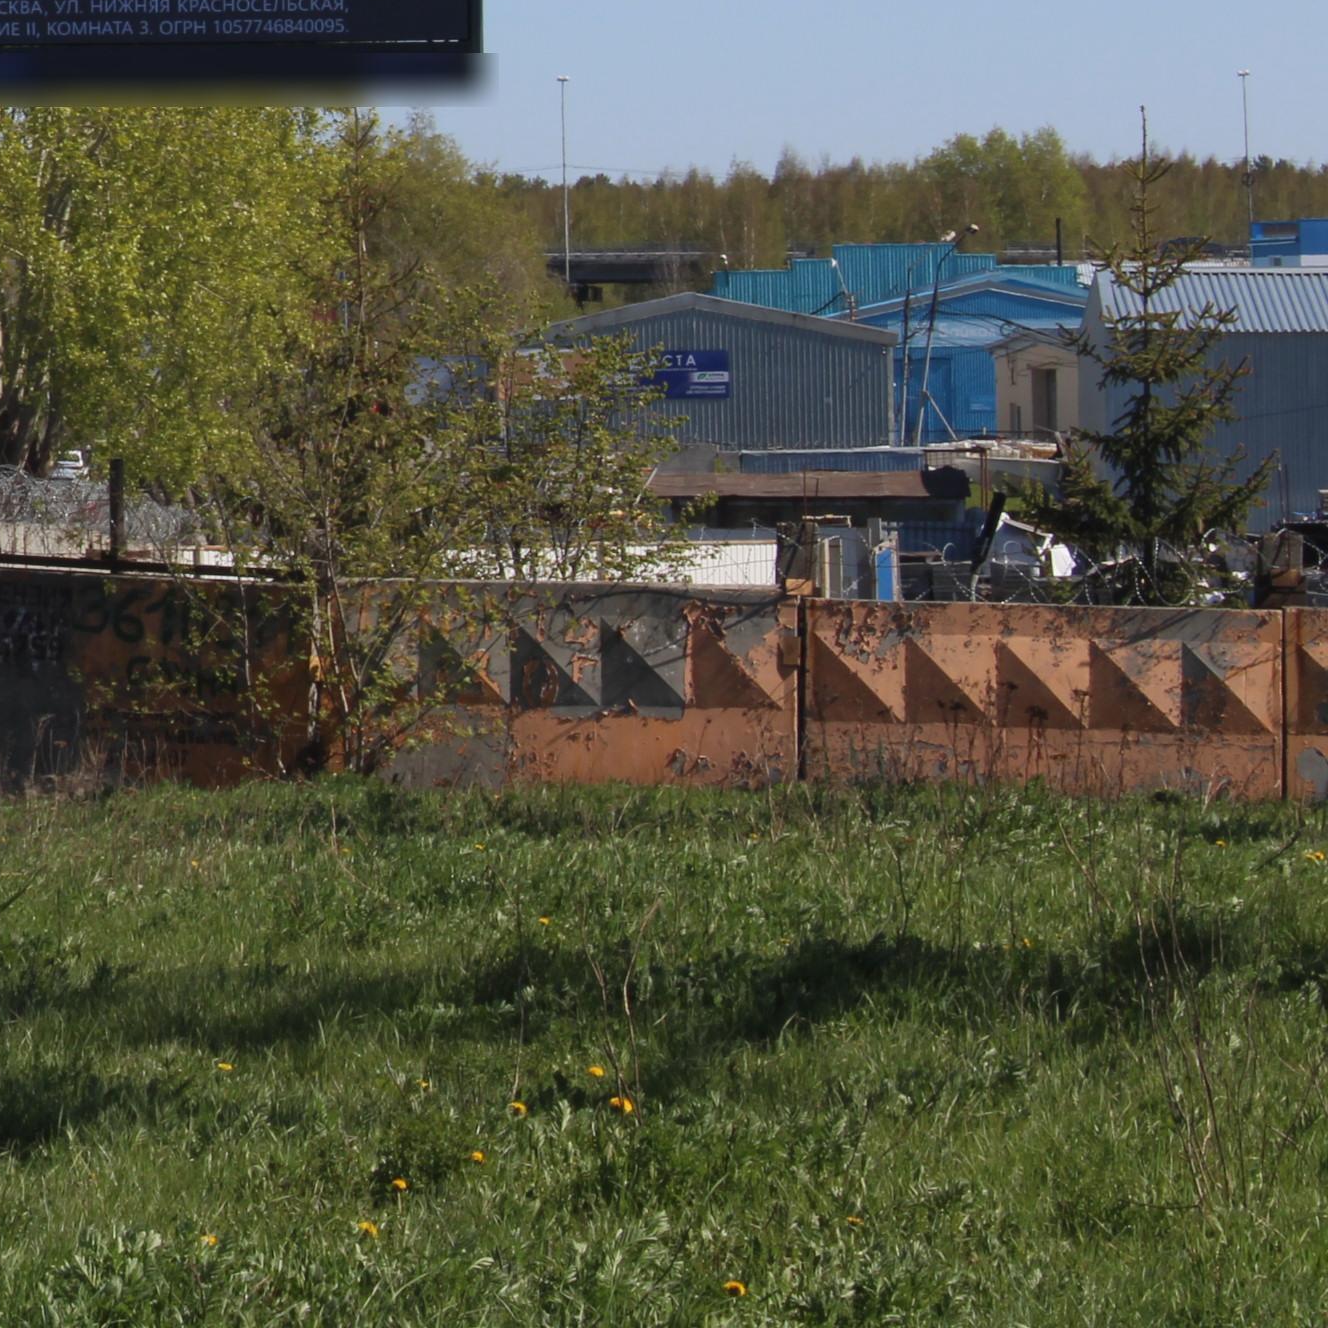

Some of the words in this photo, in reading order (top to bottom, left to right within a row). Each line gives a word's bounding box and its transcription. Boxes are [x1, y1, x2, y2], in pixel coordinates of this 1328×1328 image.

[54, 0, 83, 15] УЛ.
[47, 20, 134, 37] КОМНАТА
[139, 20, 154, 36] 3.
[159, 19, 207, 36] ОГРН
[214, 18, 350, 35] 1057746840095.
